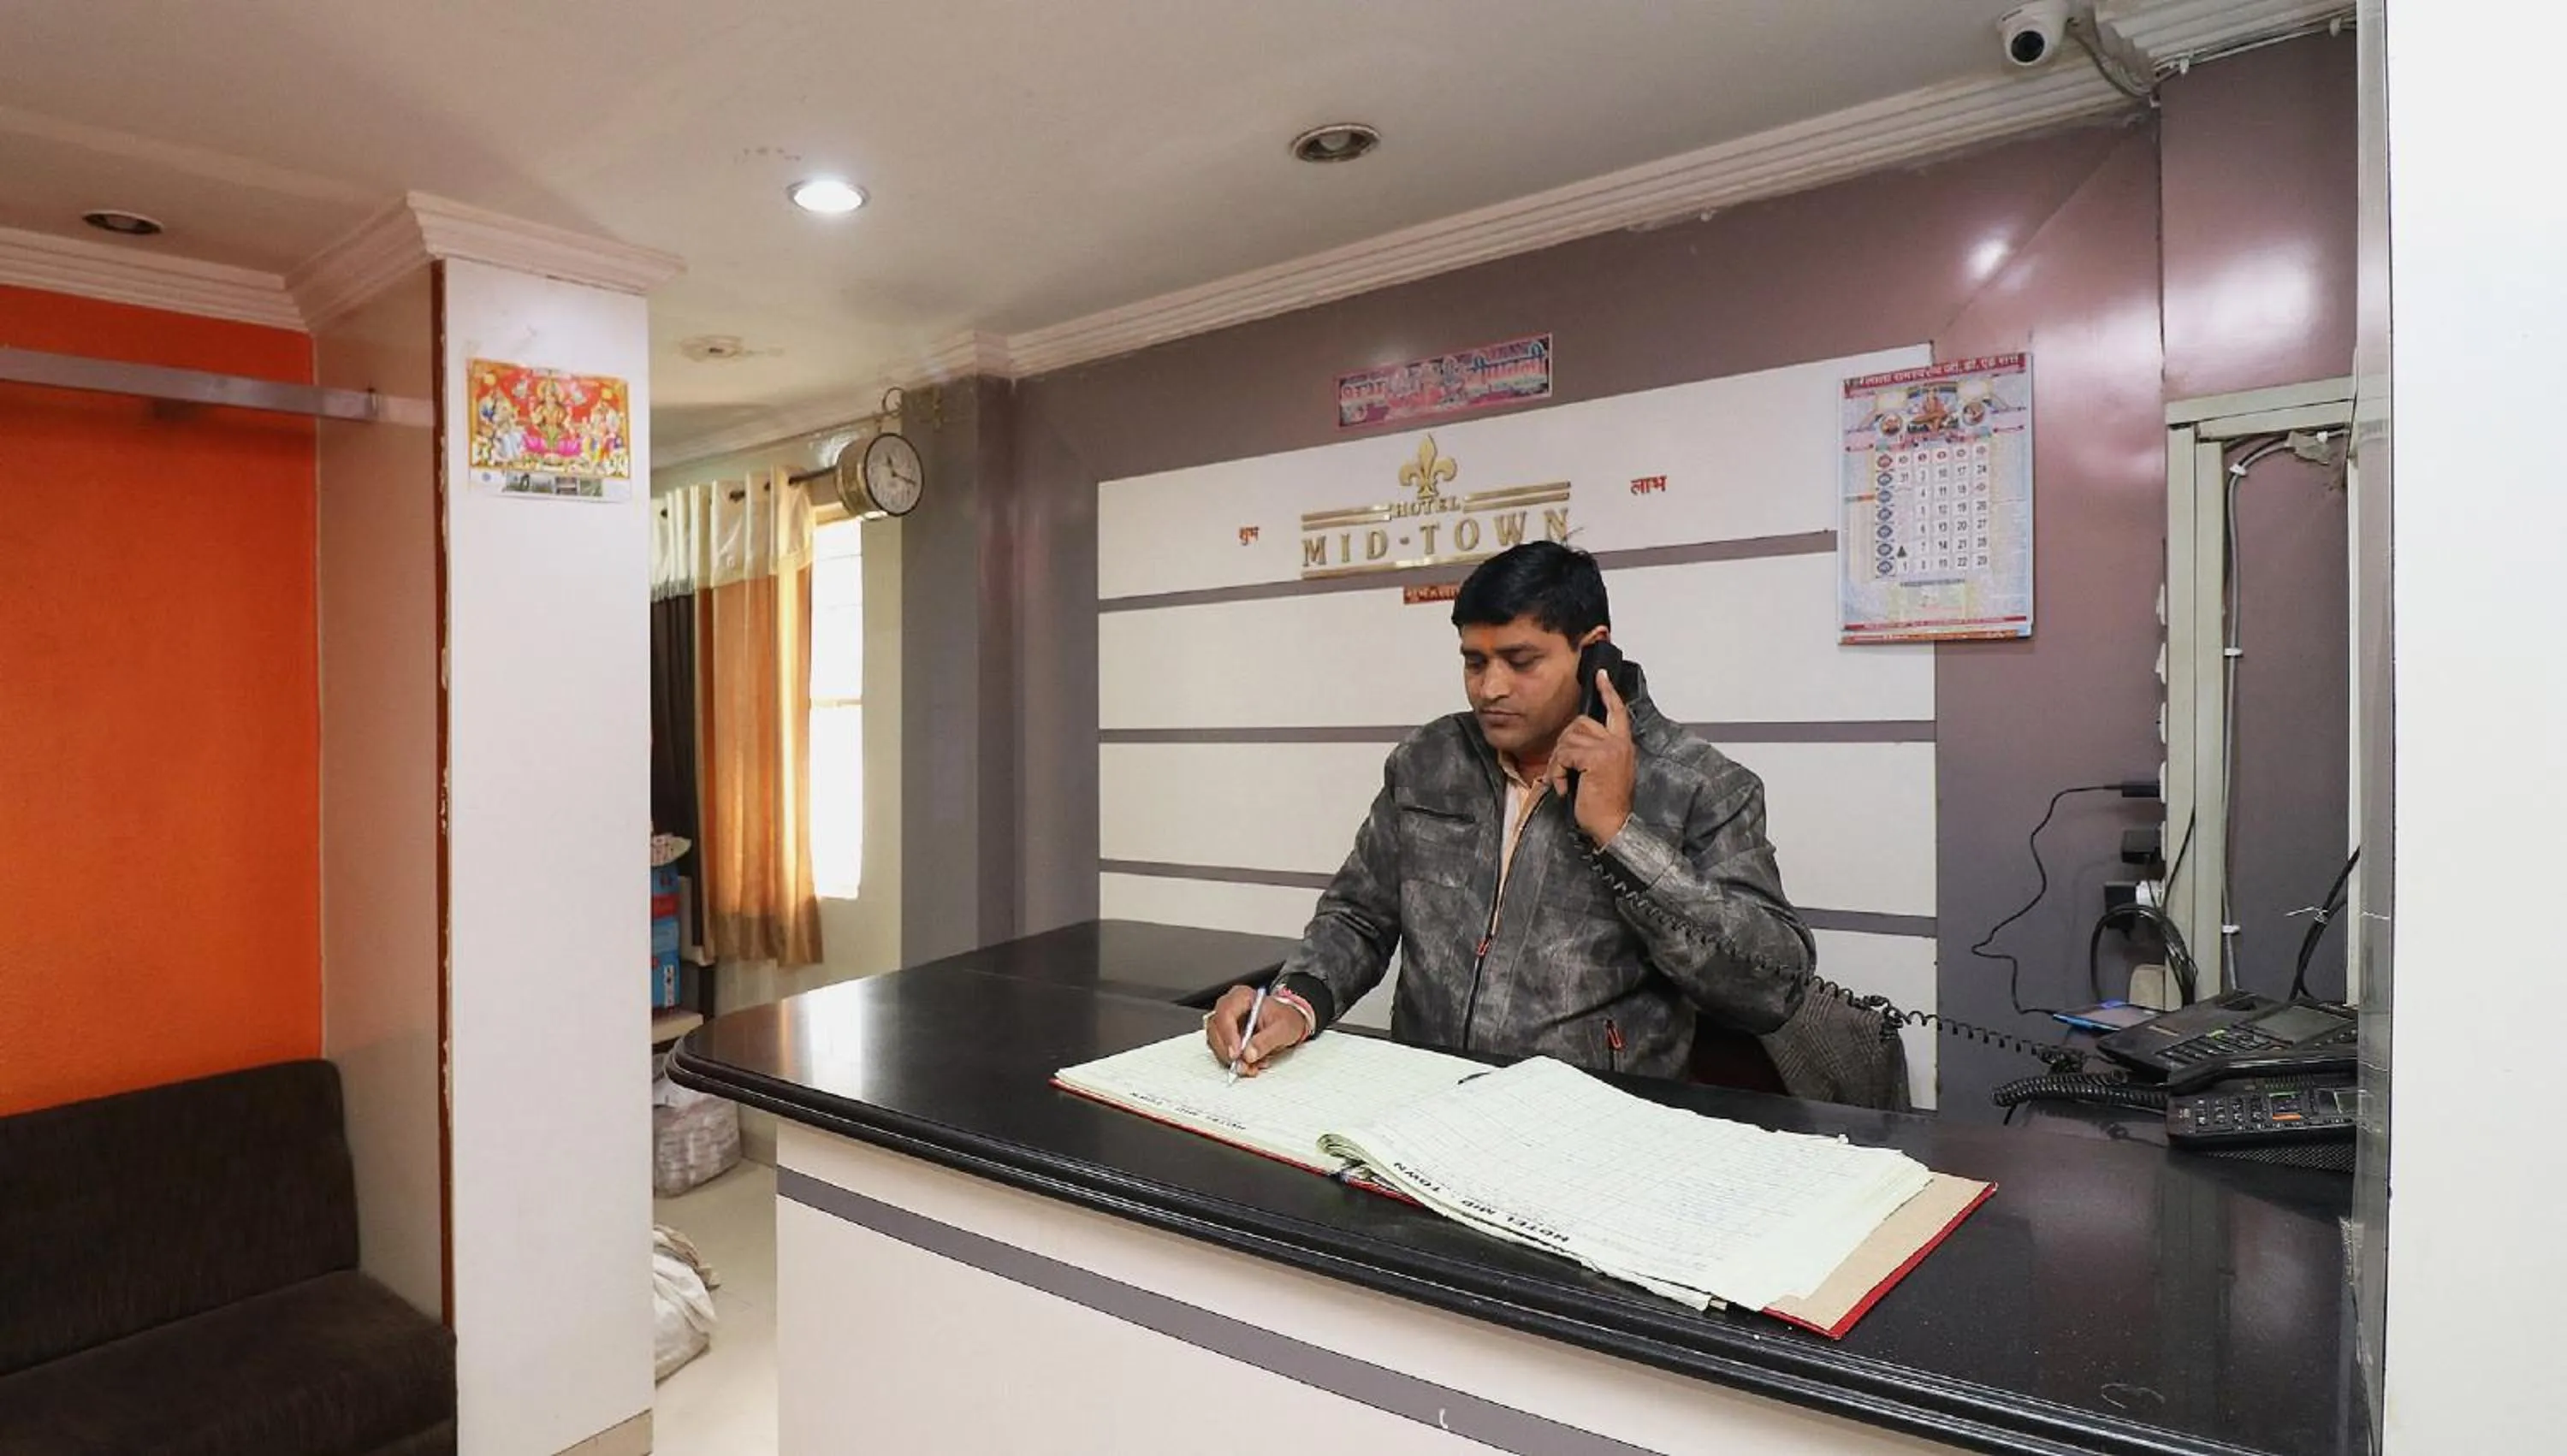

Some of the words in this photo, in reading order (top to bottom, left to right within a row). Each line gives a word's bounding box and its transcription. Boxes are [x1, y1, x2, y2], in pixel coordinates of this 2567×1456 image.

[1630, 475, 1668, 496] लाभ
[1396, 496, 1462, 518] HOTEL
[1393, 1161, 1441, 1193] TOWN
[1506, 1215, 1570, 1243] HOTEL
